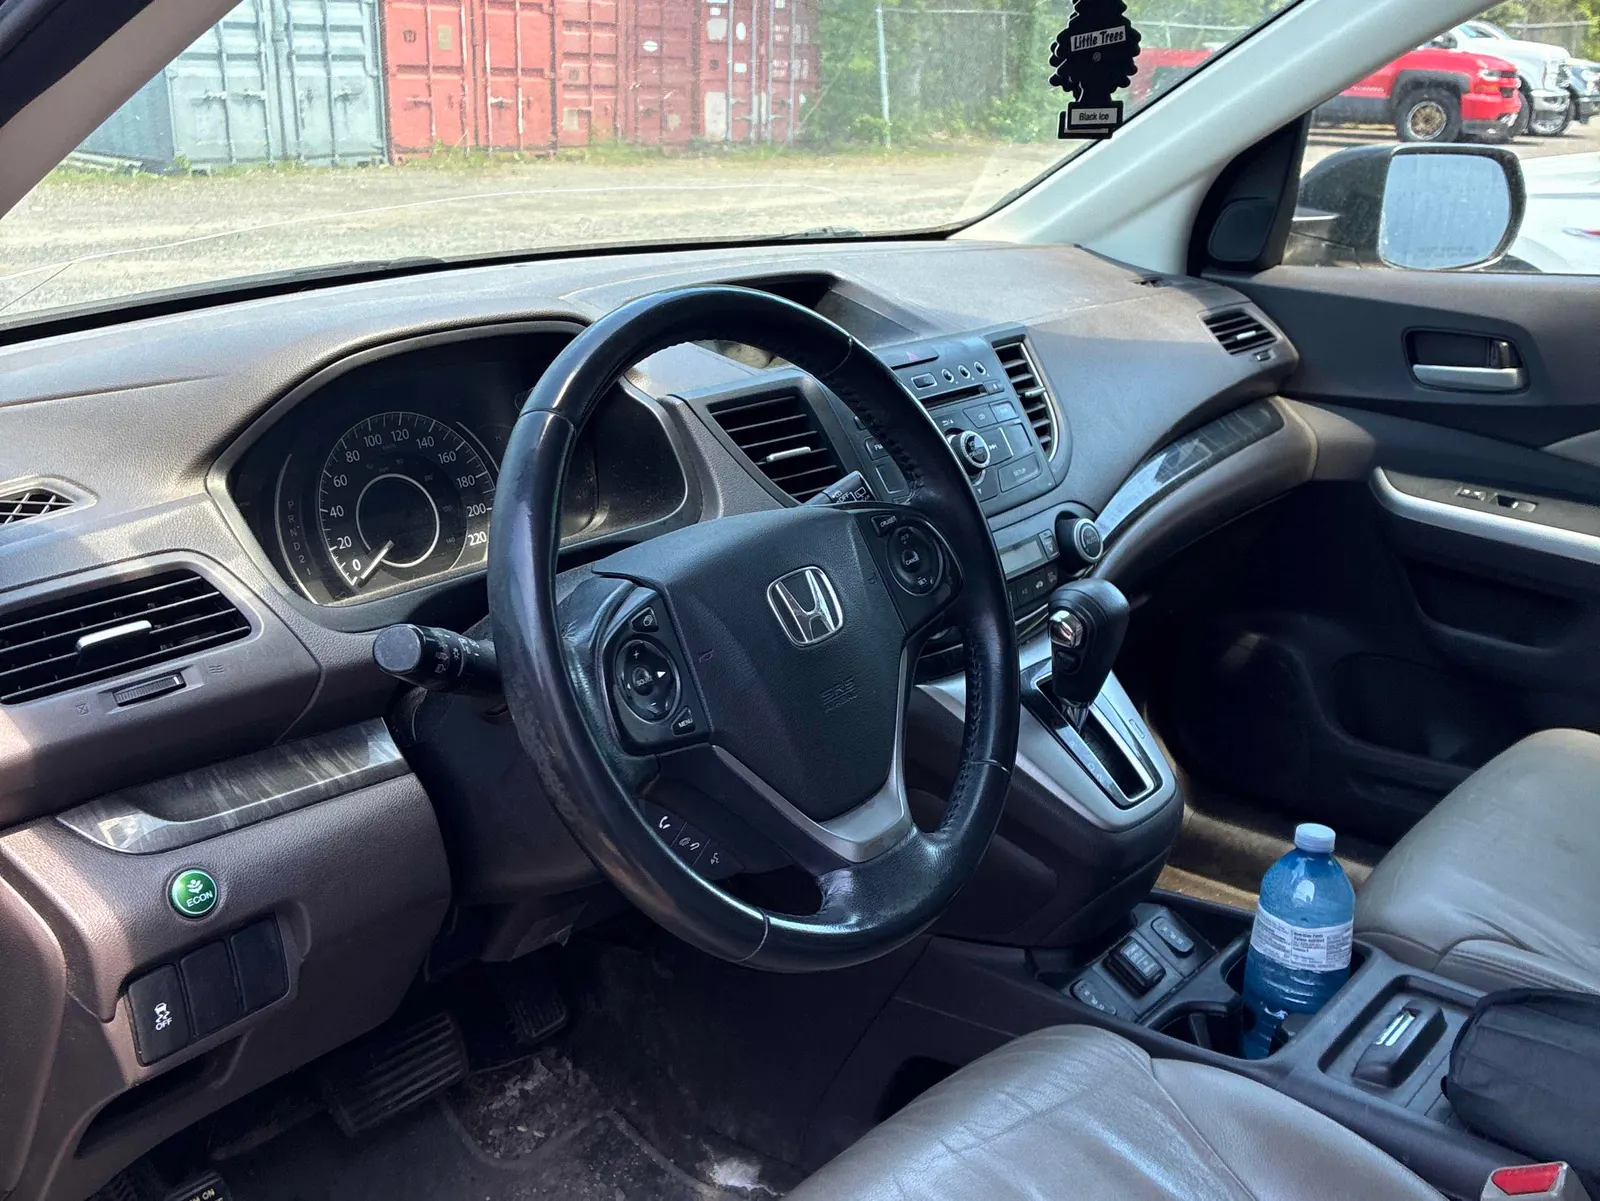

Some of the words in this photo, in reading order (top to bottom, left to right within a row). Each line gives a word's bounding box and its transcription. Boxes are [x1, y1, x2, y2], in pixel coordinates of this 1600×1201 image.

[1074, 34, 1098, 50] Little
[1100, 30, 1124, 42] Trees
[1079, 112, 1097, 121] Black
[363, 434, 382, 447] 100
[391, 428, 410, 442] 120
[416, 436, 435, 449] 140
[346, 450, 360, 463] 80
[438, 451, 457, 464] 160
[333, 474, 348, 488] 60
[456, 475, 476, 489] 180
[288, 501, 295, 510] P
[329, 505, 344, 518] 40
[467, 503, 486, 517] 200
[288, 515, 295, 524] R
[290, 528, 298, 537] N
[468, 531, 488, 546] 220
[293, 542, 301, 551] D
[337, 536, 352, 550] 20
[299, 555, 306, 564] 2
[353, 559, 362, 571] 0
[679, 718, 693, 728] MENU
[186, 890, 213, 907] ECON
[155, 1018, 173, 1031] OFF
[202, 1188, 215, 1200] ON
